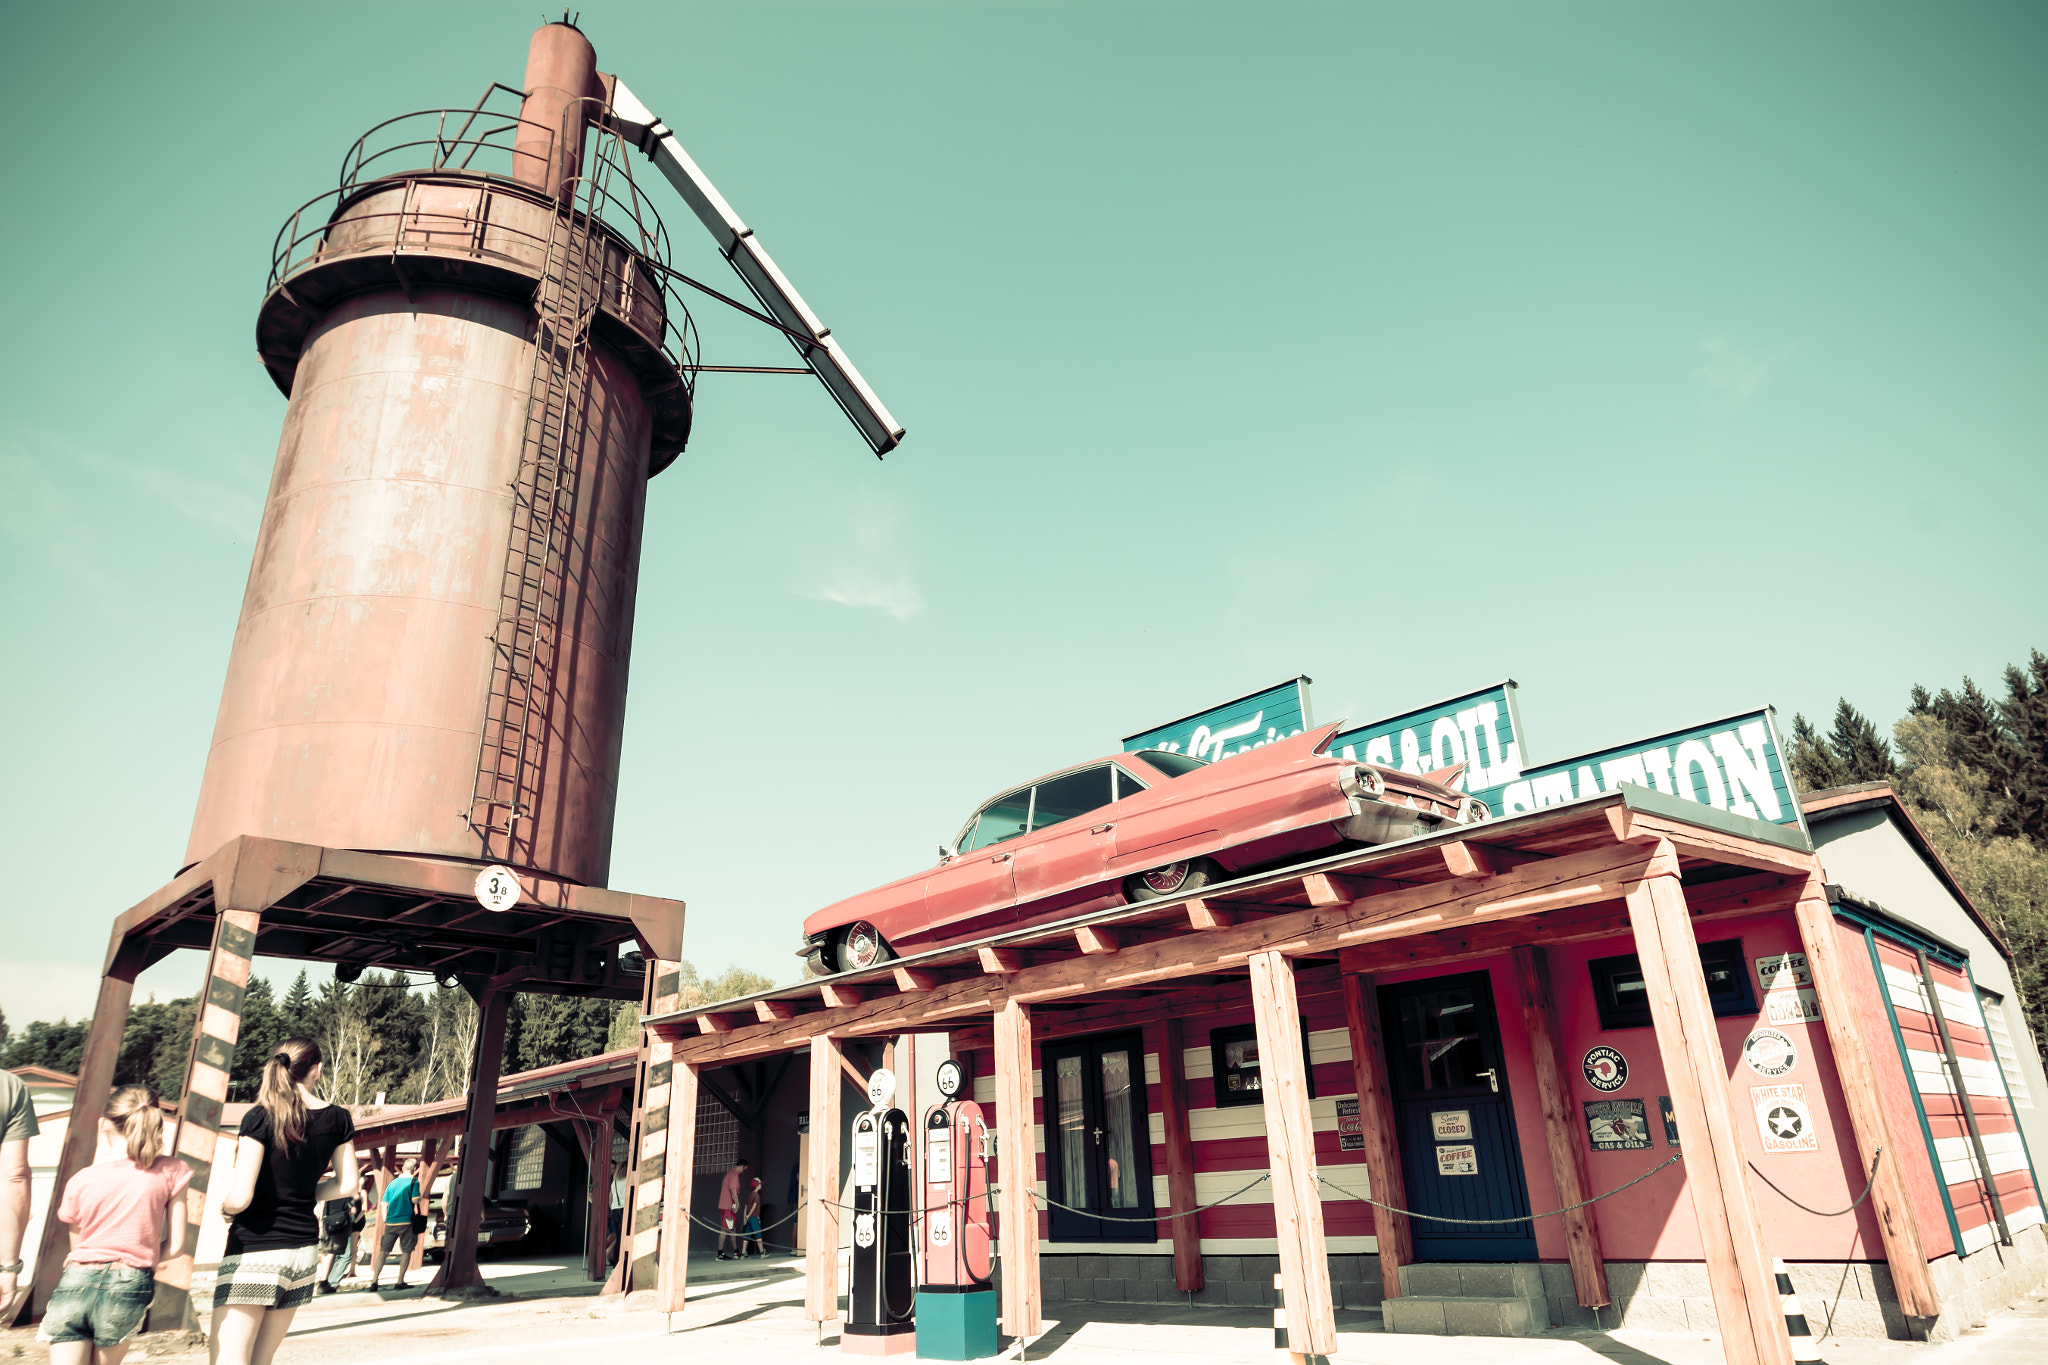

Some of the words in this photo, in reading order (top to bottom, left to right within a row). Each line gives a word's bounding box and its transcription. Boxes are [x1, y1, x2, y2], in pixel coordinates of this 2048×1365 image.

[1760, 957, 1806, 976] COFFEE
[1587, 1049, 1621, 1065] PONTIAC
[1758, 1061, 1790, 1075] SERVICE
[942, 1076, 955, 1090] 66
[1591, 1074, 1624, 1090] SERVICE
[871, 1084, 882, 1097] 66
[1751, 1087, 1780, 1107] WHITE
[1780, 1085, 1806, 1105] STAR
[1438, 1124, 1466, 1135] CLOSED
[1598, 1141, 1615, 1150] GAS
[1616, 1141, 1624, 1149] &
[1624, 1140, 1645, 1149] OILS
[1764, 1131, 1817, 1150] GASOLINE
[1440, 1149, 1473, 1163] COFFEE
[859, 1226, 872, 1242] 66
[933, 1225, 948, 1241] 66
